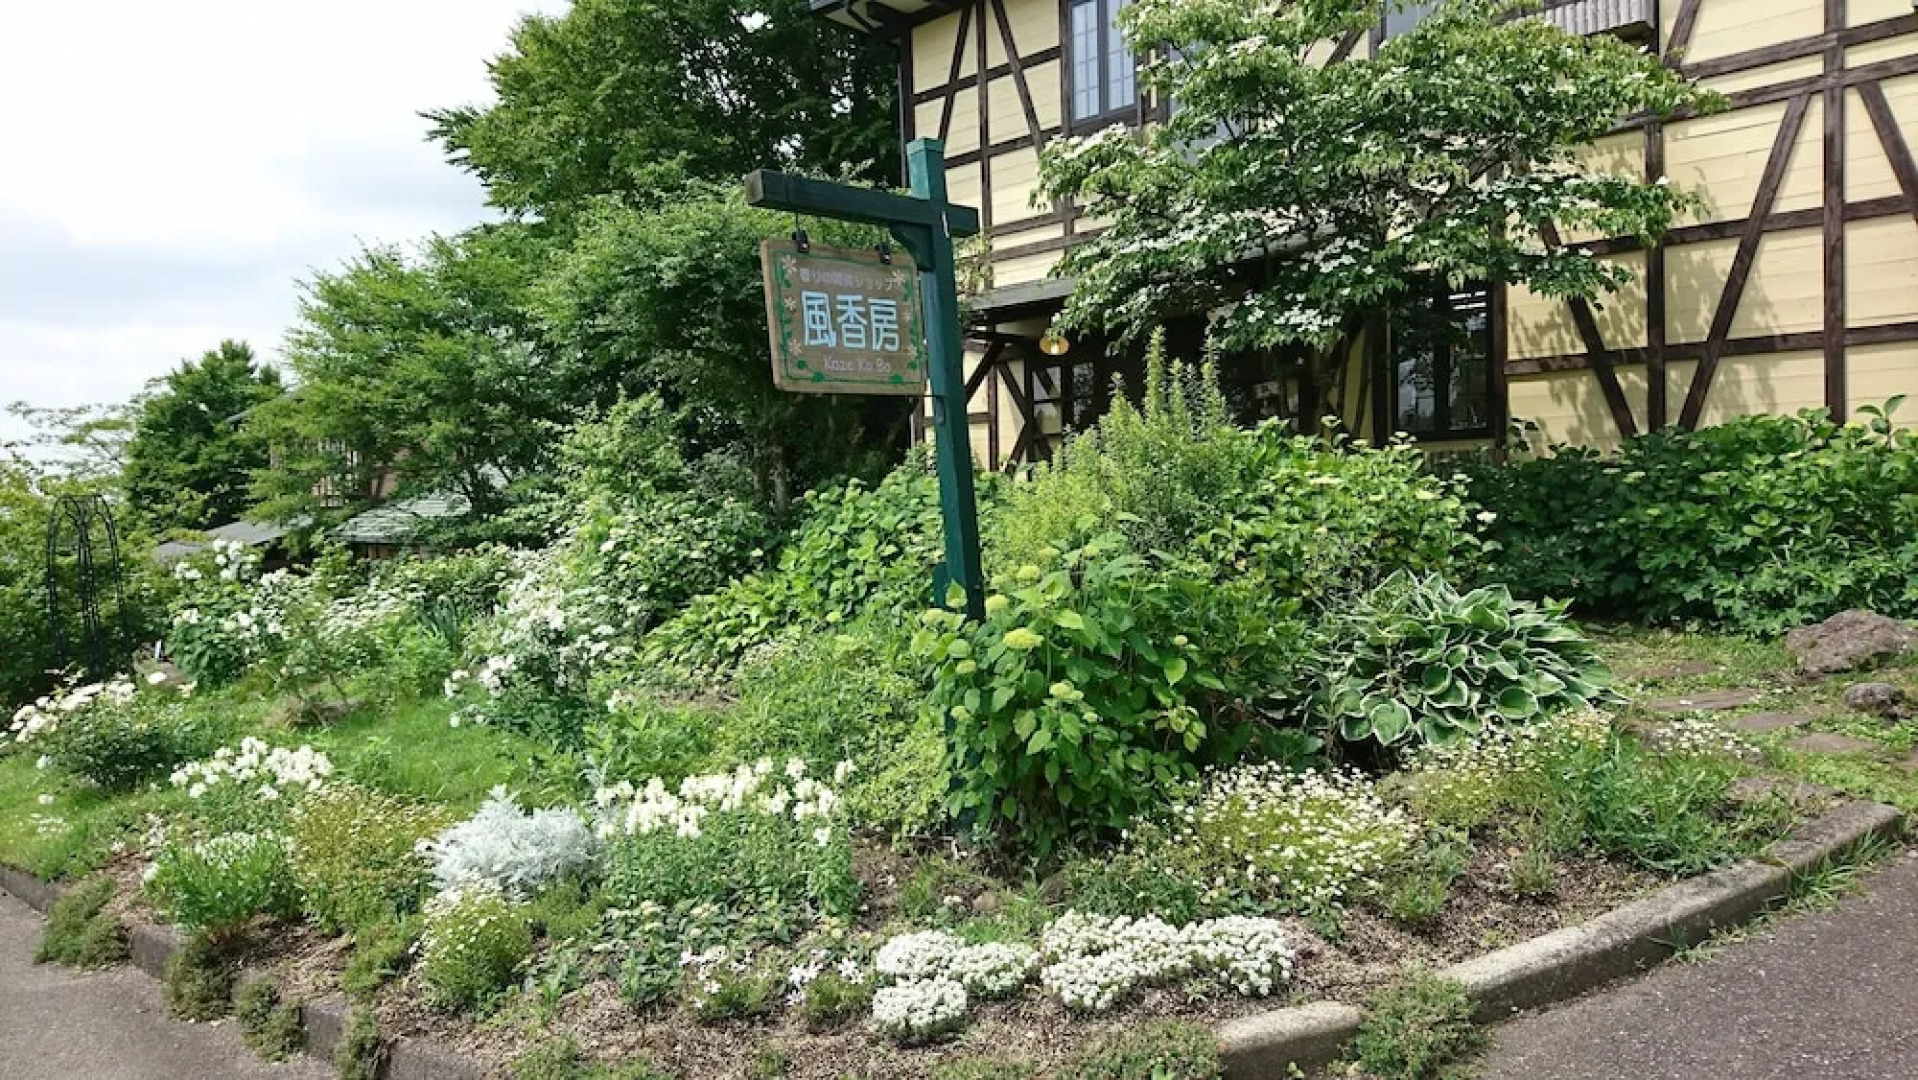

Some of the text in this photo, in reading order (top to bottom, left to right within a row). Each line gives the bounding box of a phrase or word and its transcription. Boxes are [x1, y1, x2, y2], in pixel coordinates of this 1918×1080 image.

[802, 291, 899, 351] 風香房
[824, 356, 854, 371] Kaze
